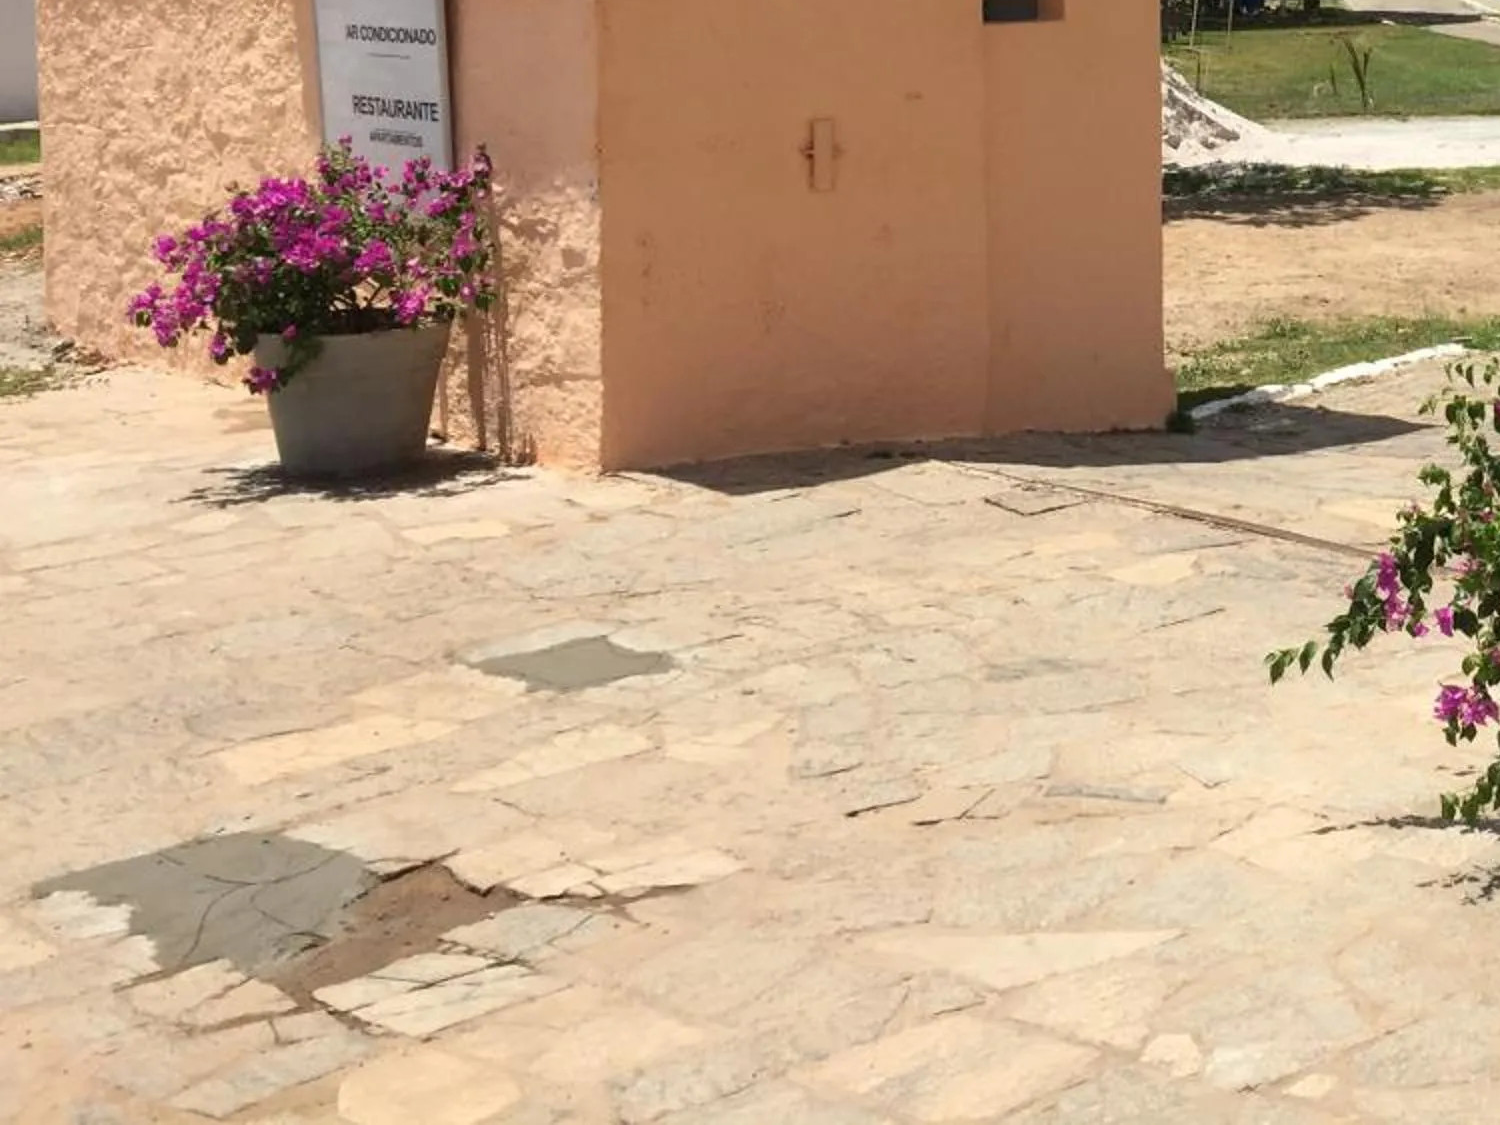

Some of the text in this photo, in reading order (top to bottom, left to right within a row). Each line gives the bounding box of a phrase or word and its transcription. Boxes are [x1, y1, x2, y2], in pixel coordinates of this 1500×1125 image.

[346, 25, 437, 46] AR CONDICIONADO
[351, 95, 440, 122] RESTAURANTE
